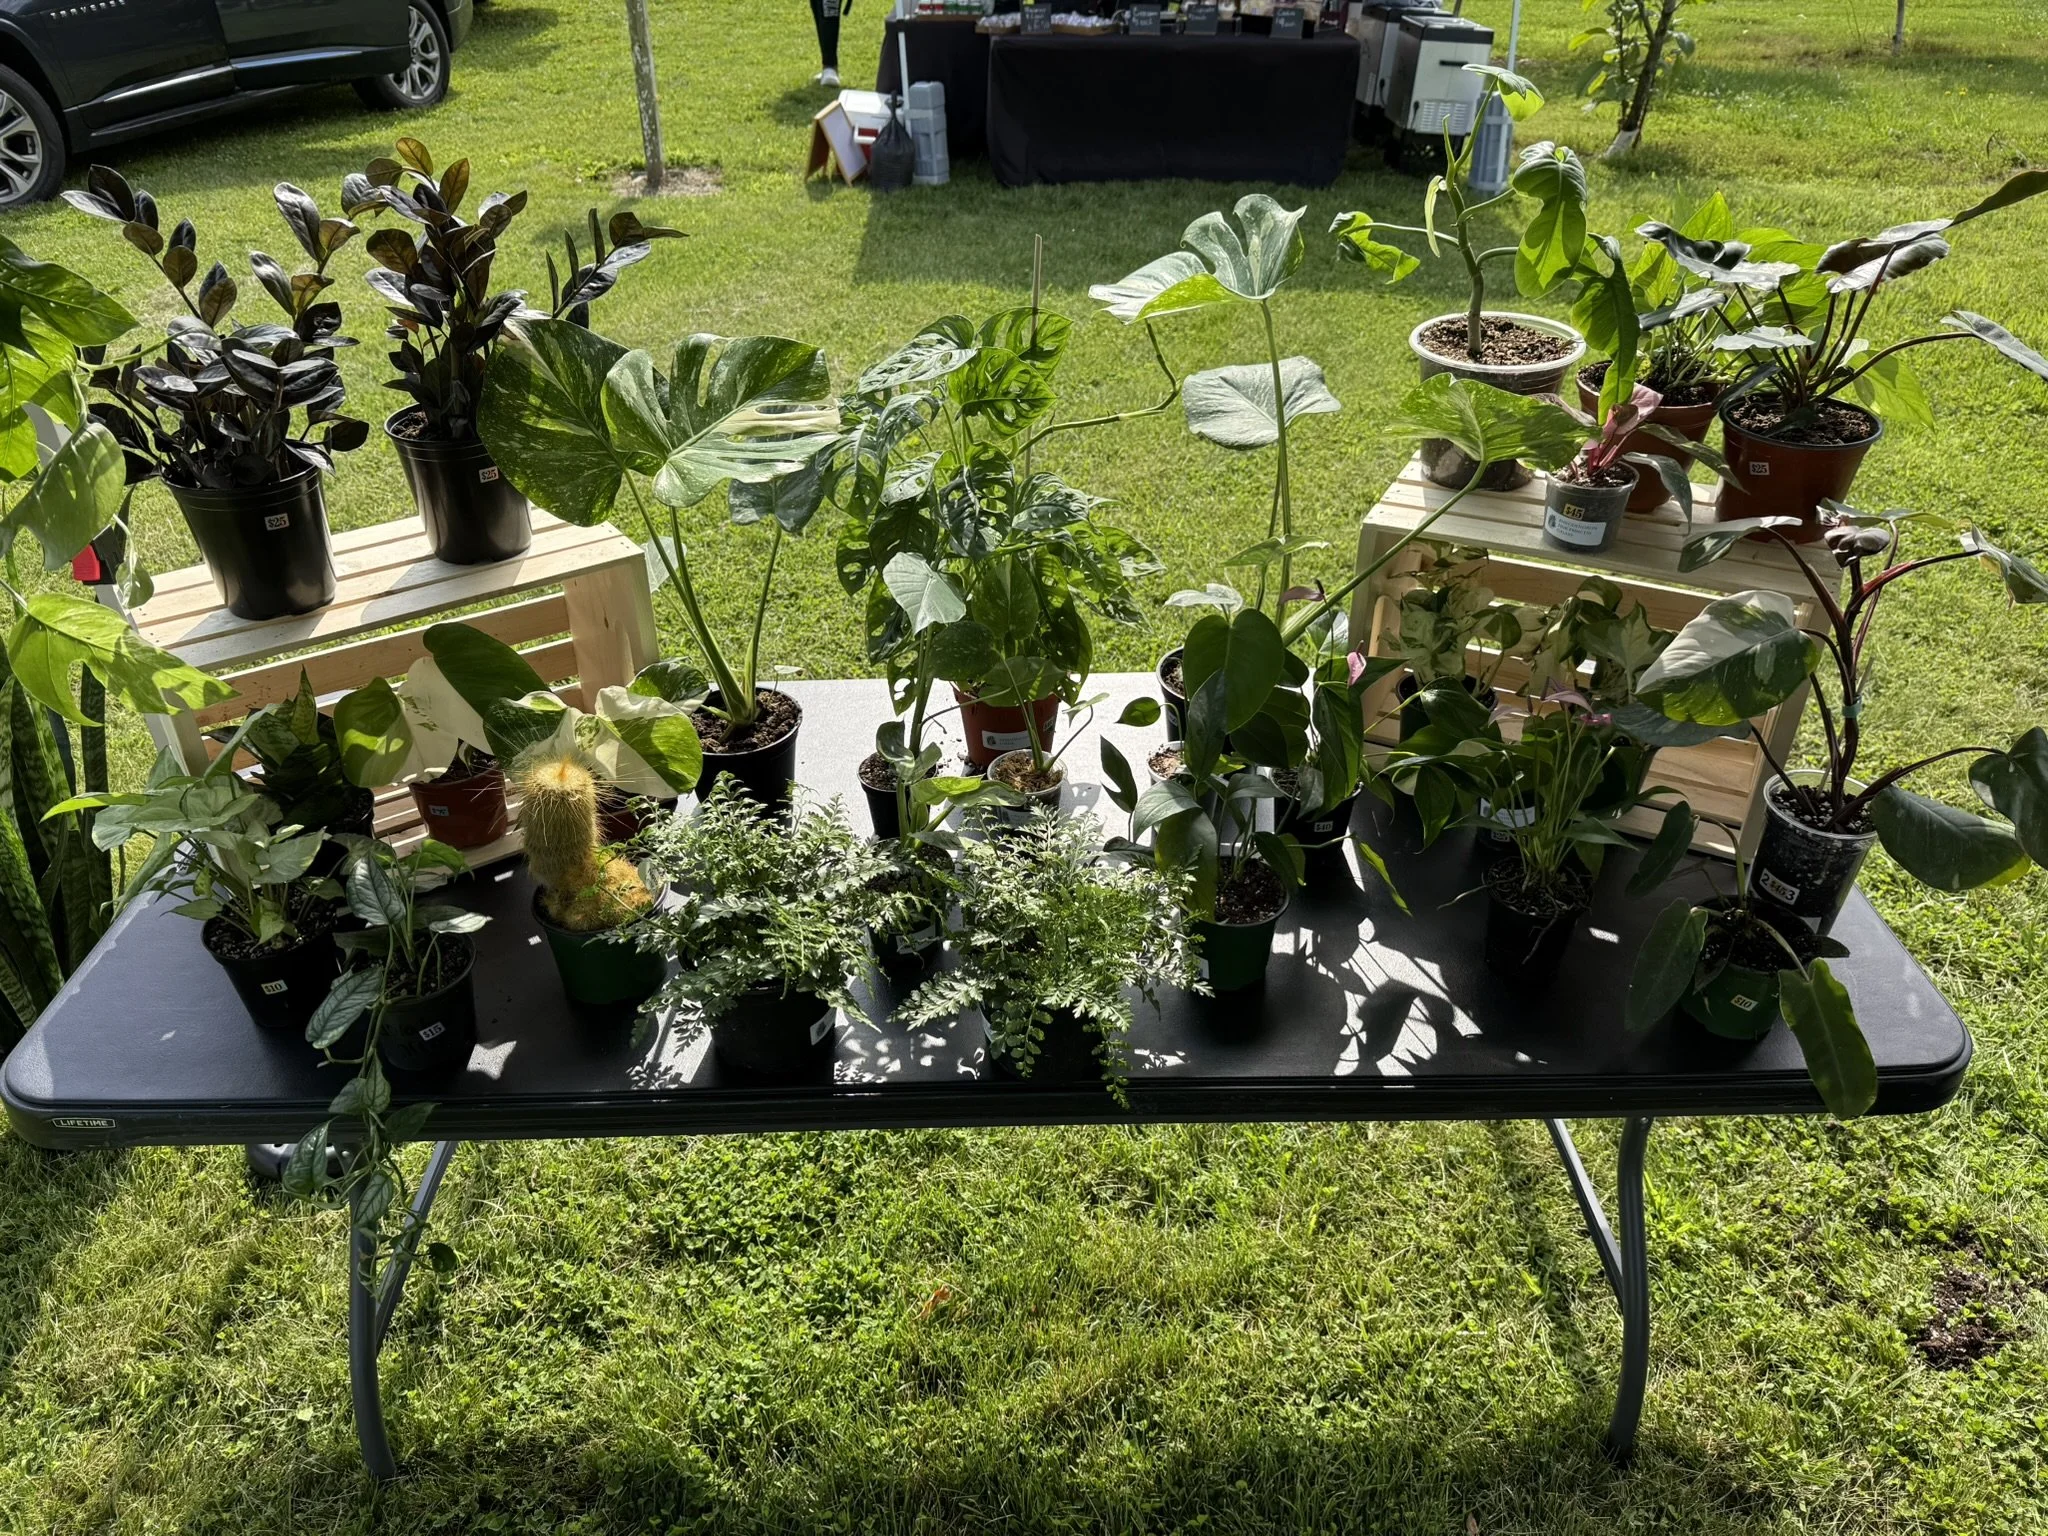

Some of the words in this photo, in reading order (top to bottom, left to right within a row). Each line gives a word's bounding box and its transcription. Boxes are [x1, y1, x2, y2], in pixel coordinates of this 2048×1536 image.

[481, 468, 497, 481] $25
[1751, 463, 1768, 474] $25
[1565, 506, 1583, 519] $45
[267, 516, 287, 528] $25
[264, 982, 283, 993] $10
[1734, 996, 1753, 1008] $10
[422, 1024, 443, 1039] $15
